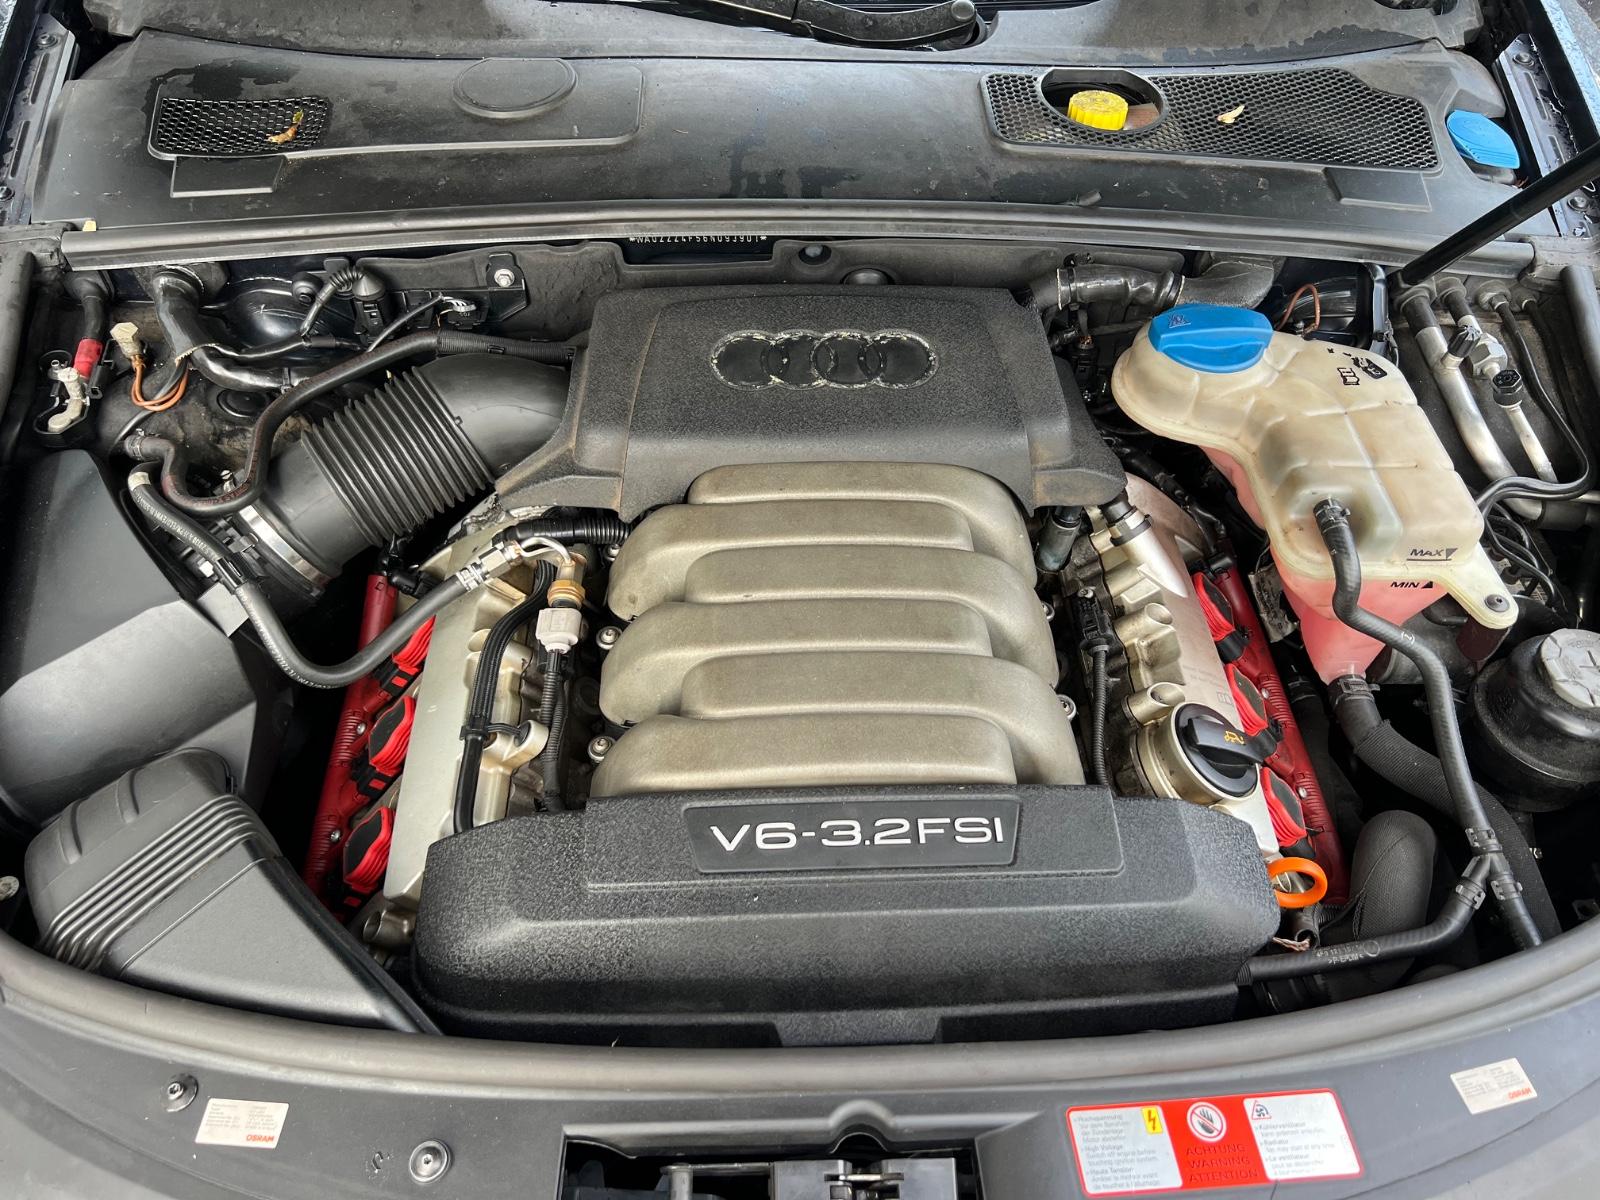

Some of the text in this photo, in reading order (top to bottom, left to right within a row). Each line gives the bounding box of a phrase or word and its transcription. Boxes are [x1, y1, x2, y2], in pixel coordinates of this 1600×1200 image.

[1410, 548, 1444, 556] MAX
[710, 817, 1004, 851] V6-3.2FSI
[246, 1134, 275, 1143] OSRAM
[1186, 1144, 1246, 1156] ACHTUNG
[1188, 1156, 1250, 1169] WARNING
[1188, 1169, 1258, 1183] ATTENTION
